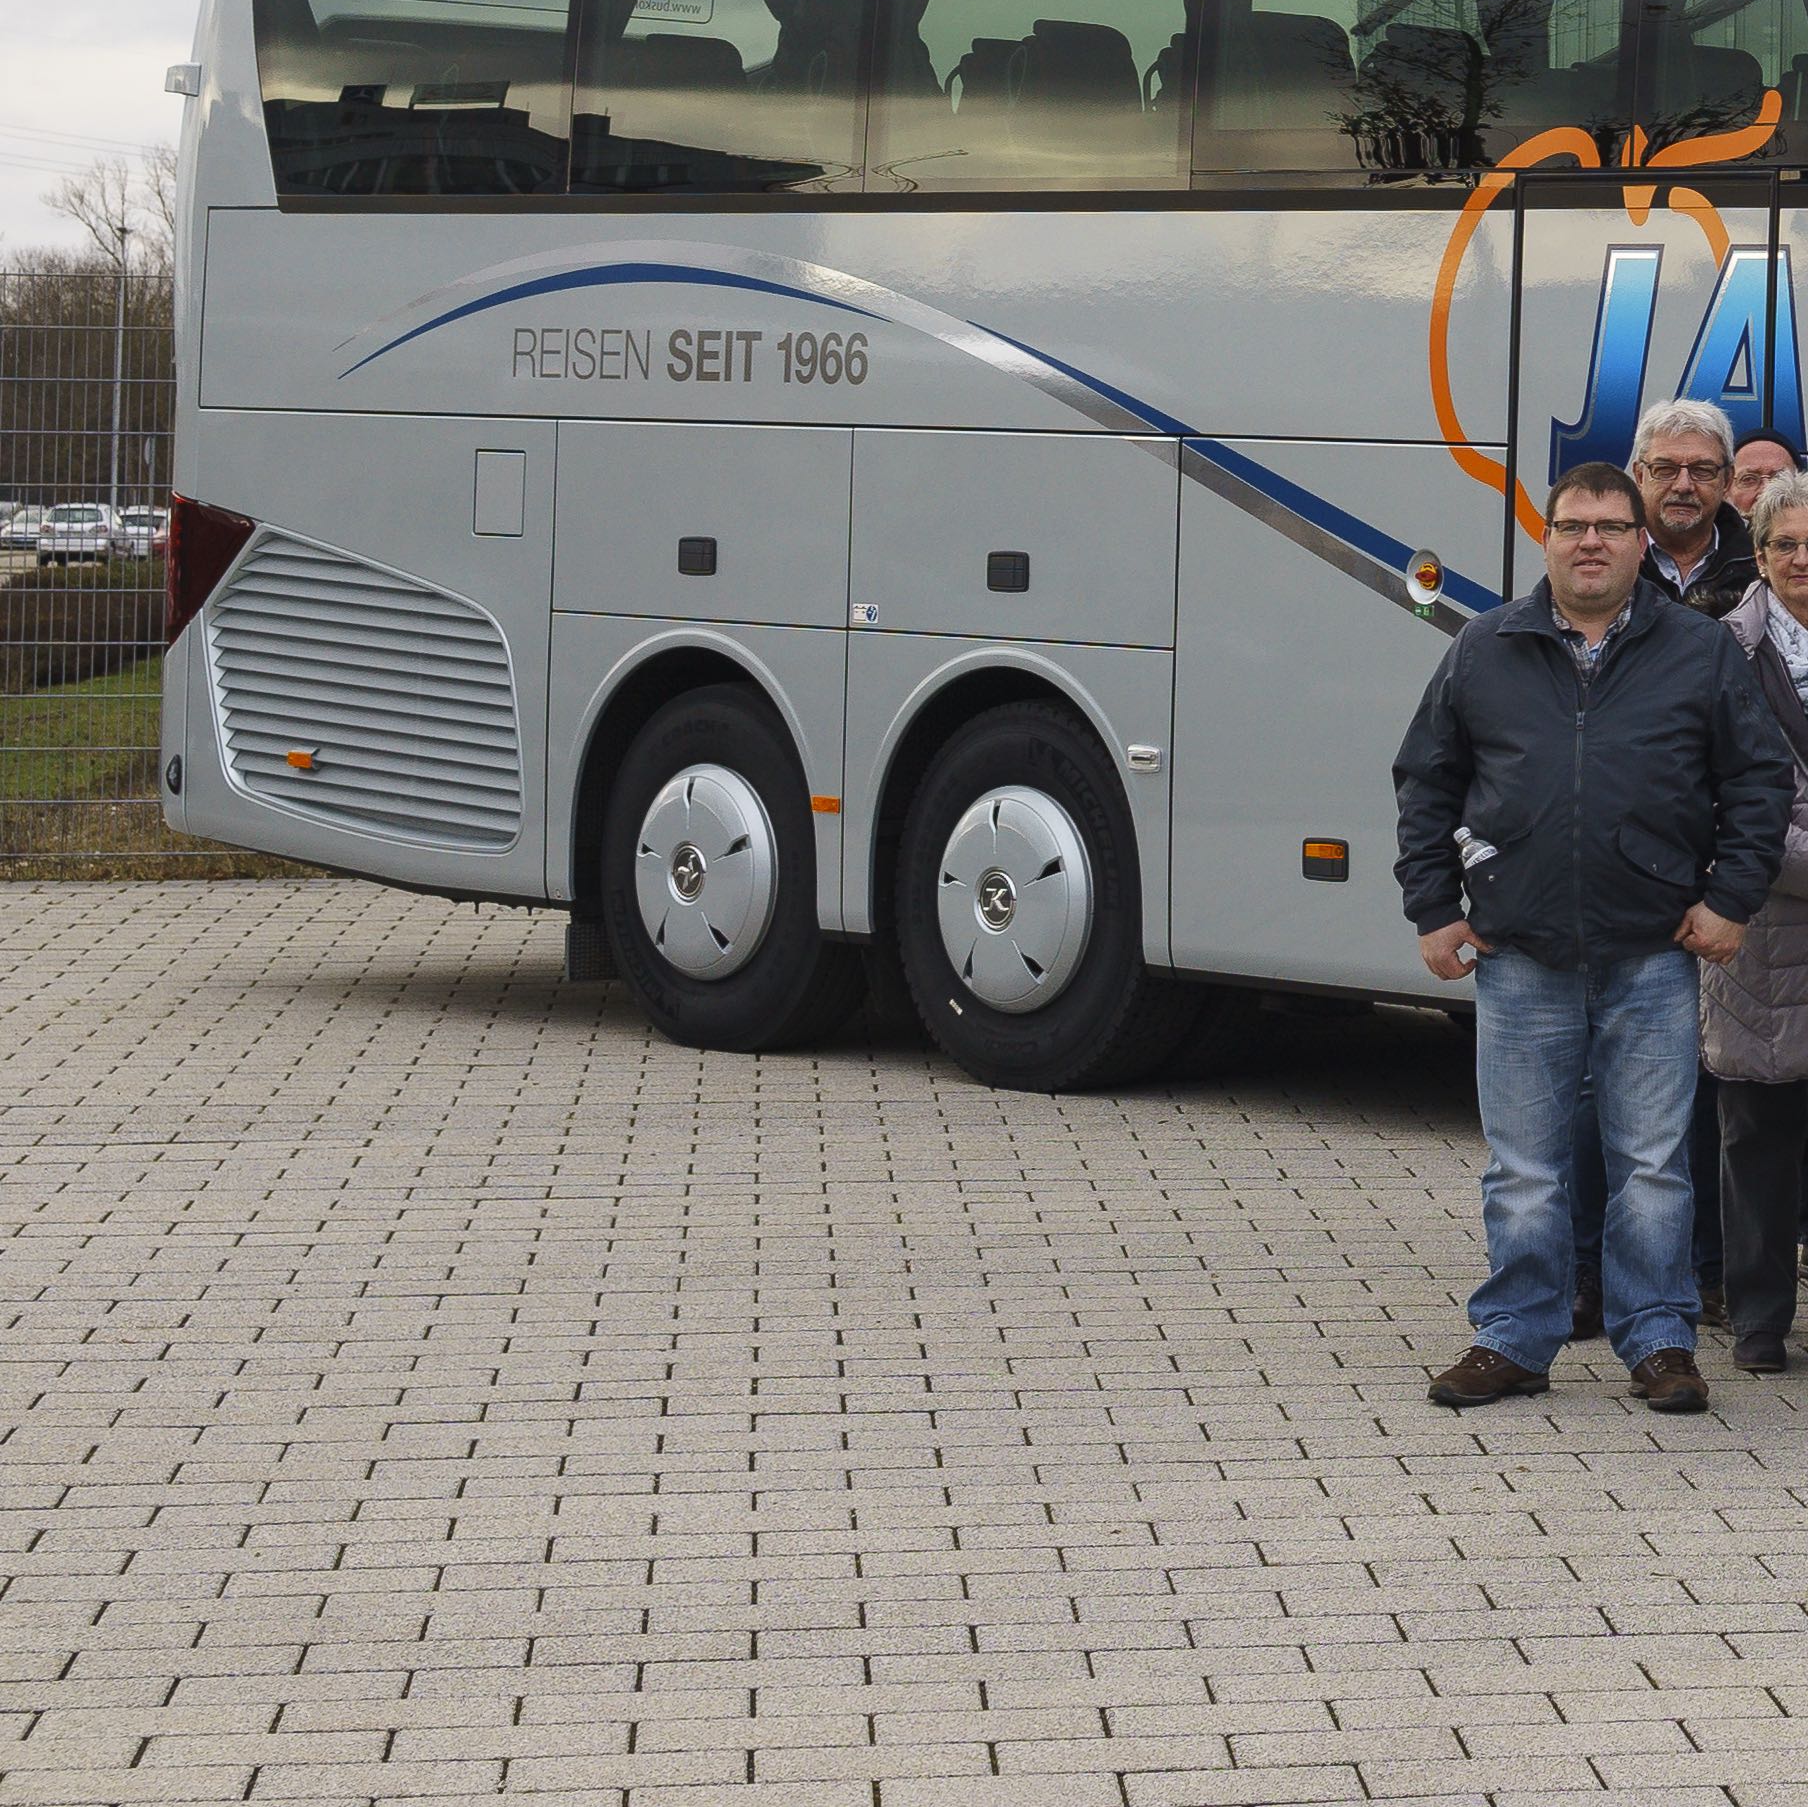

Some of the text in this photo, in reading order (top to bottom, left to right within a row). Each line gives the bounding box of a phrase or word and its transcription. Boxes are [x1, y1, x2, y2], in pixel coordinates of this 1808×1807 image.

[512, 327, 869, 385] REISEN SEIT 1966
